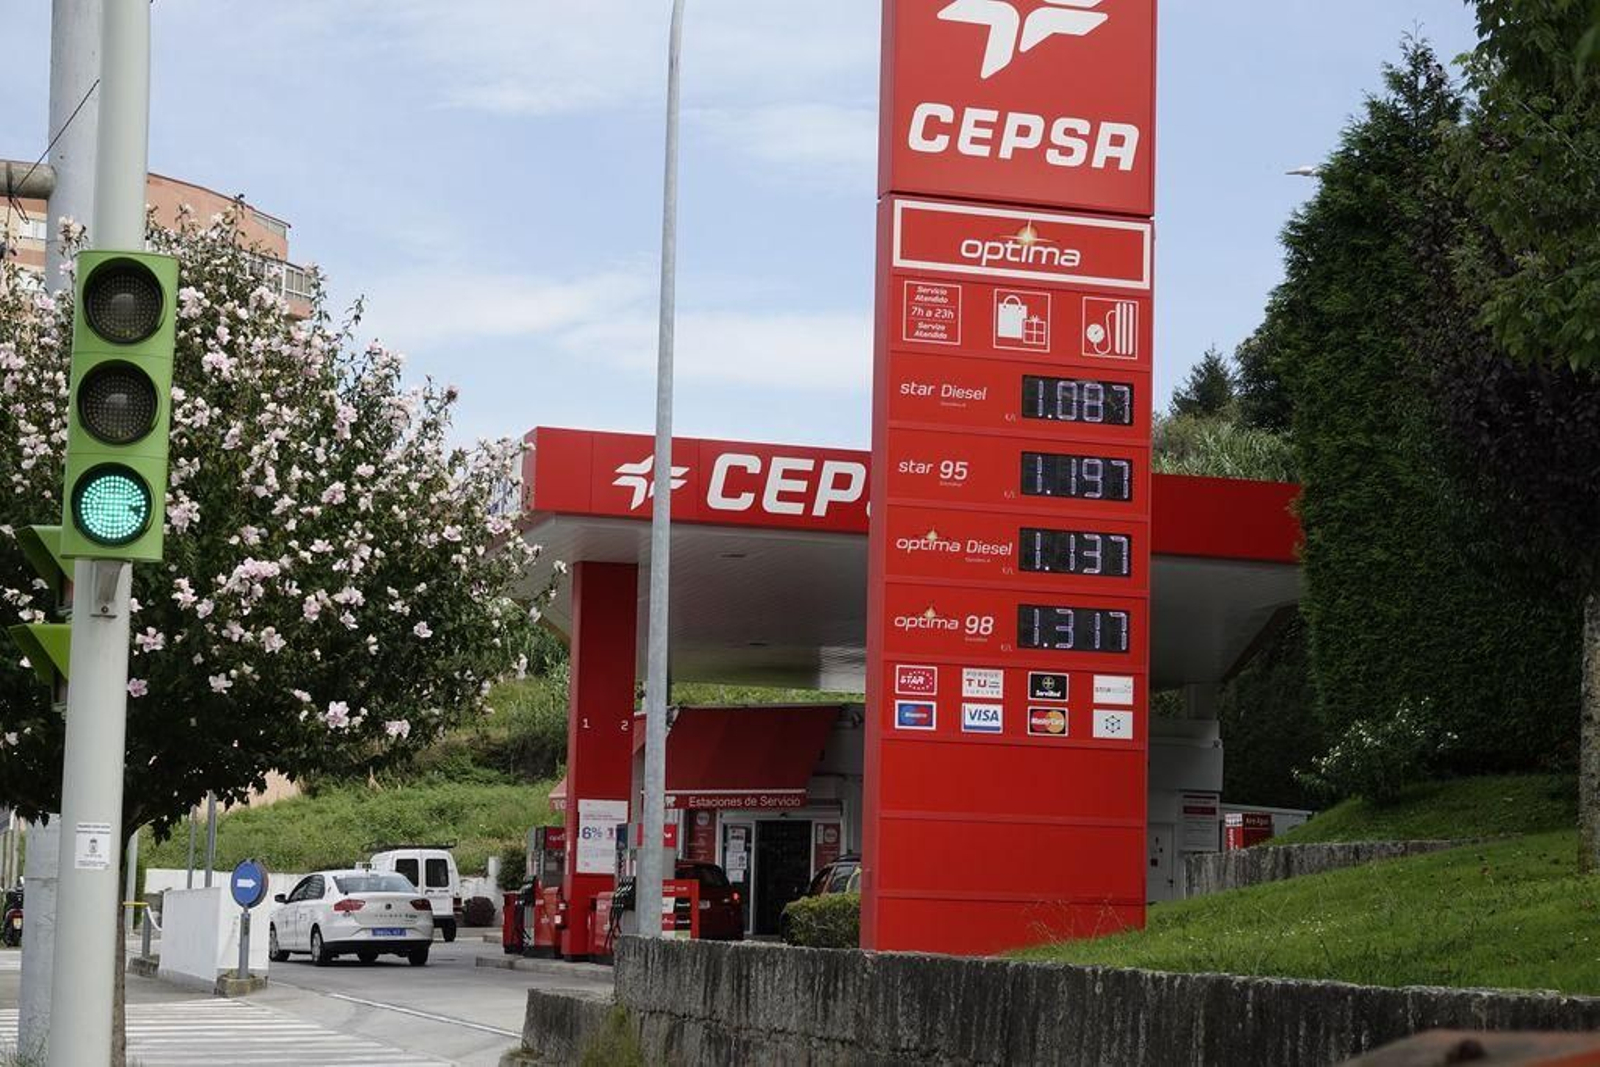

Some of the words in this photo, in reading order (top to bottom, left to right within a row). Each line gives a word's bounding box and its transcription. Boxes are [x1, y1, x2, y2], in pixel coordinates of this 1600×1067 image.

[908, 102, 1140, 171] CEPSA
[961, 238, 1081, 266] optima
[914, 294, 949, 304] Atendido
[916, 286, 948, 295] Servicio
[911, 306, 924, 316] 7h
[934, 308, 955, 319] 23h
[914, 330, 948, 339] Atendido
[900, 381, 934, 397] star
[941, 383, 987, 400] Diesel
[1038, 380, 1130, 424] 1.087
[898, 459, 934, 475] star
[939, 459, 969, 480] 95
[1037, 455, 1130, 499] 1.197
[706, 453, 871, 517] CEP
[896, 538, 960, 554] optima
[966, 539, 1013, 556] Diesel
[1035, 531, 1129, 574] 1.137
[894, 615, 959, 632] optima
[965, 615, 994, 635] 98
[1033, 608, 1128, 651] 1.317
[900, 675, 925, 685] STAR
[583, 718, 590, 729] 1
[968, 708, 999, 722] VISA
[621, 720, 629, 731] 2
[688, 796, 742, 807] Estaciones
[744, 796, 758, 806] de
[759, 795, 801, 807] Servicio
